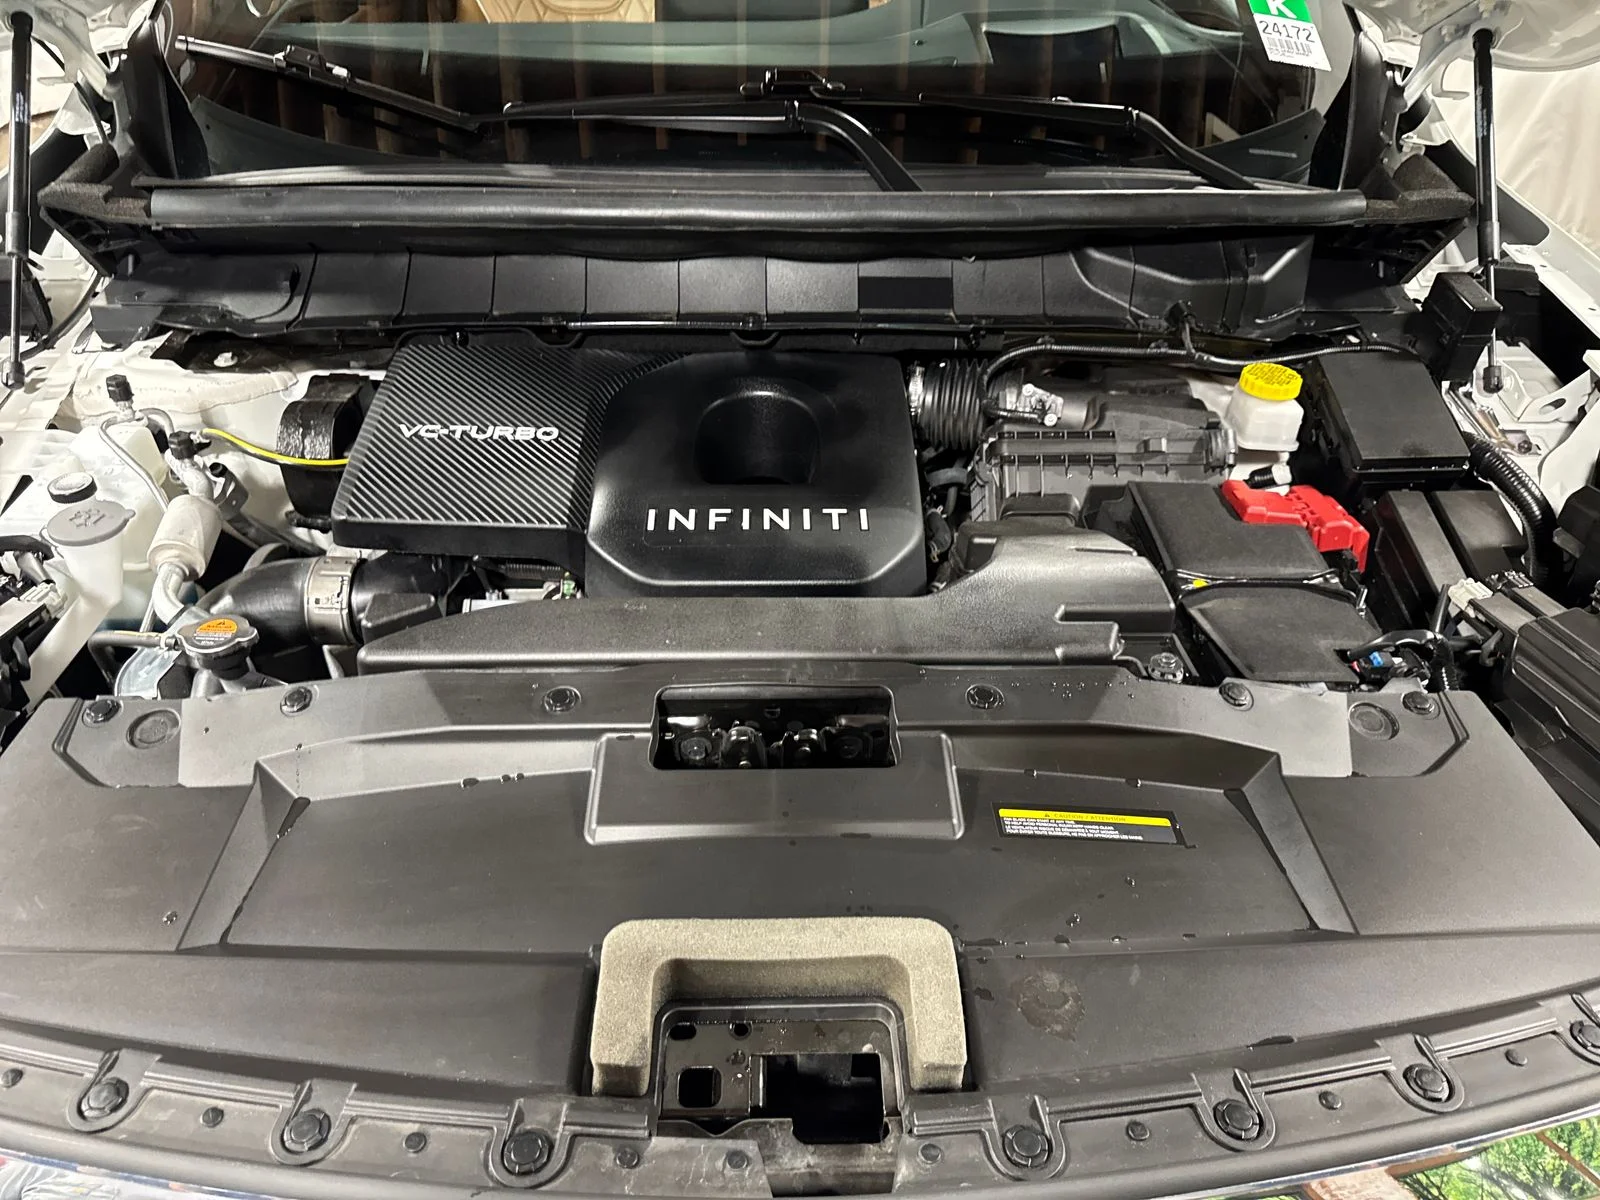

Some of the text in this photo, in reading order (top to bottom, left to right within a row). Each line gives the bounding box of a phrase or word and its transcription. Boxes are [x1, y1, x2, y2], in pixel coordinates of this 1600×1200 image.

[1259, 20, 1315, 43] 24172
[399, 423, 559, 441] VC-TURBO
[647, 508, 869, 531] INFINITI
[1053, 812, 1084, 820] CAUTION
[1090, 814, 1126, 823] ATTENTION
